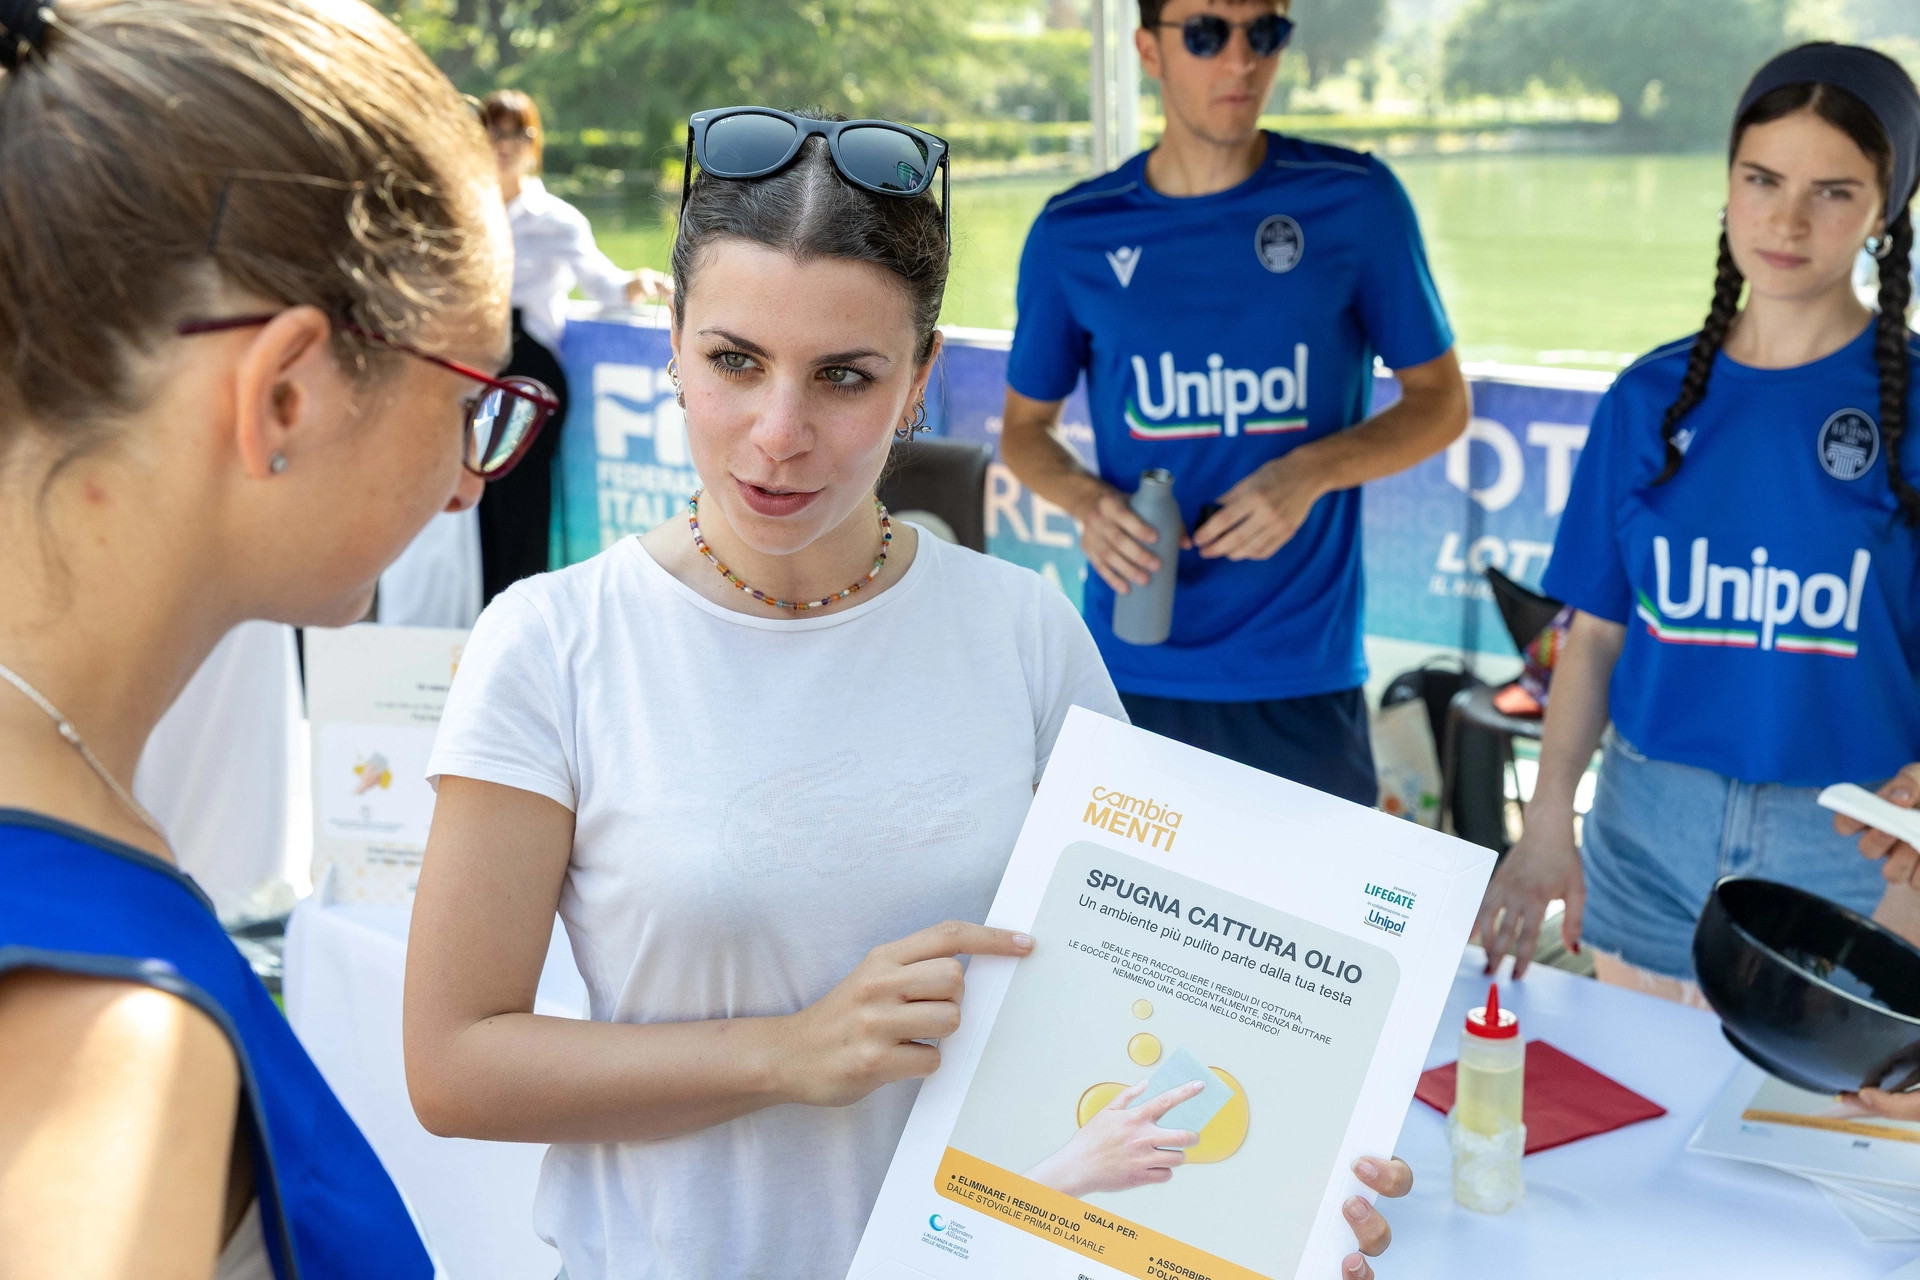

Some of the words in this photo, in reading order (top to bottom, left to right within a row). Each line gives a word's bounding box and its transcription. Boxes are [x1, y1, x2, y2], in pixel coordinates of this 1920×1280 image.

[1131, 342, 1309, 437] Unipol
[1653, 535, 1871, 651] Unipol
[1083, 802, 1177, 852] MENTI
[1087, 869, 1180, 919] SPUGNA
[1188, 907, 1297, 962] CATTURA
[1305, 950, 1363, 984] OLIO
[1364, 883, 1415, 909] LIFEGATE
[1368, 909, 1406, 933] Unipol
[1079, 894, 1097, 911] Un
[1100, 905, 1159, 933] ambiente
[1160, 927, 1182, 942] più
[1183, 936, 1220, 956] pulito
[1221, 950, 1257, 970] parte
[1260, 963, 1292, 984] dalla
[1295, 975, 1316, 993] tua
[1319, 984, 1352, 1007] testa
[1101, 941, 1131, 958] IDEALE
[1131, 952, 1149, 965] PER
[1150, 959, 1210, 988] RACCOGLIERE
[1215, 983, 1250, 1003] RESIDUI
[1250, 997, 1261, 1007] DI
[1261, 1001, 1303, 1024] COTTURA,
[1068, 940, 1080, 950] LE
[1080, 944, 1111, 961] GOCCE
[1111, 955, 1121, 965] DI
[1121, 959, 1142, 973] OLIO
[1142, 967, 1177, 986] CADUTE
[1177, 981, 1260, 1019] ACCIDENTALMENTE,
[1262, 1012, 1290, 1030] SENZA
[1291, 1024, 1333, 1045] BUTTARE
[1112, 967, 1156, 989] NEMMENO
[1156, 983, 1174, 996] UNA
[1175, 991, 1208, 1009] GOCCIA
[1209, 1004, 1238, 1020] NELLO
[1238, 1015, 1281, 1037] SCARICO!
[946, 1182, 976, 1201] DALLE
[976, 1194, 1023, 1220] STOVIGLIE
[1023, 1214, 1051, 1233] PRIMA
[1053, 1226, 1064, 1237] DI
[1064, 1231, 1106, 1255] LAVARLE
[958, 1175, 1007, 1202] ELIMINARE
[1006, 1196, 1012, 1204] I
[1012, 1198, 1049, 1219] RESIDUI
[1049, 1213, 1081, 1232] D'OLIO
[1084, 1211, 1114, 1231] USALA
[1116, 1225, 1139, 1241] PER:
